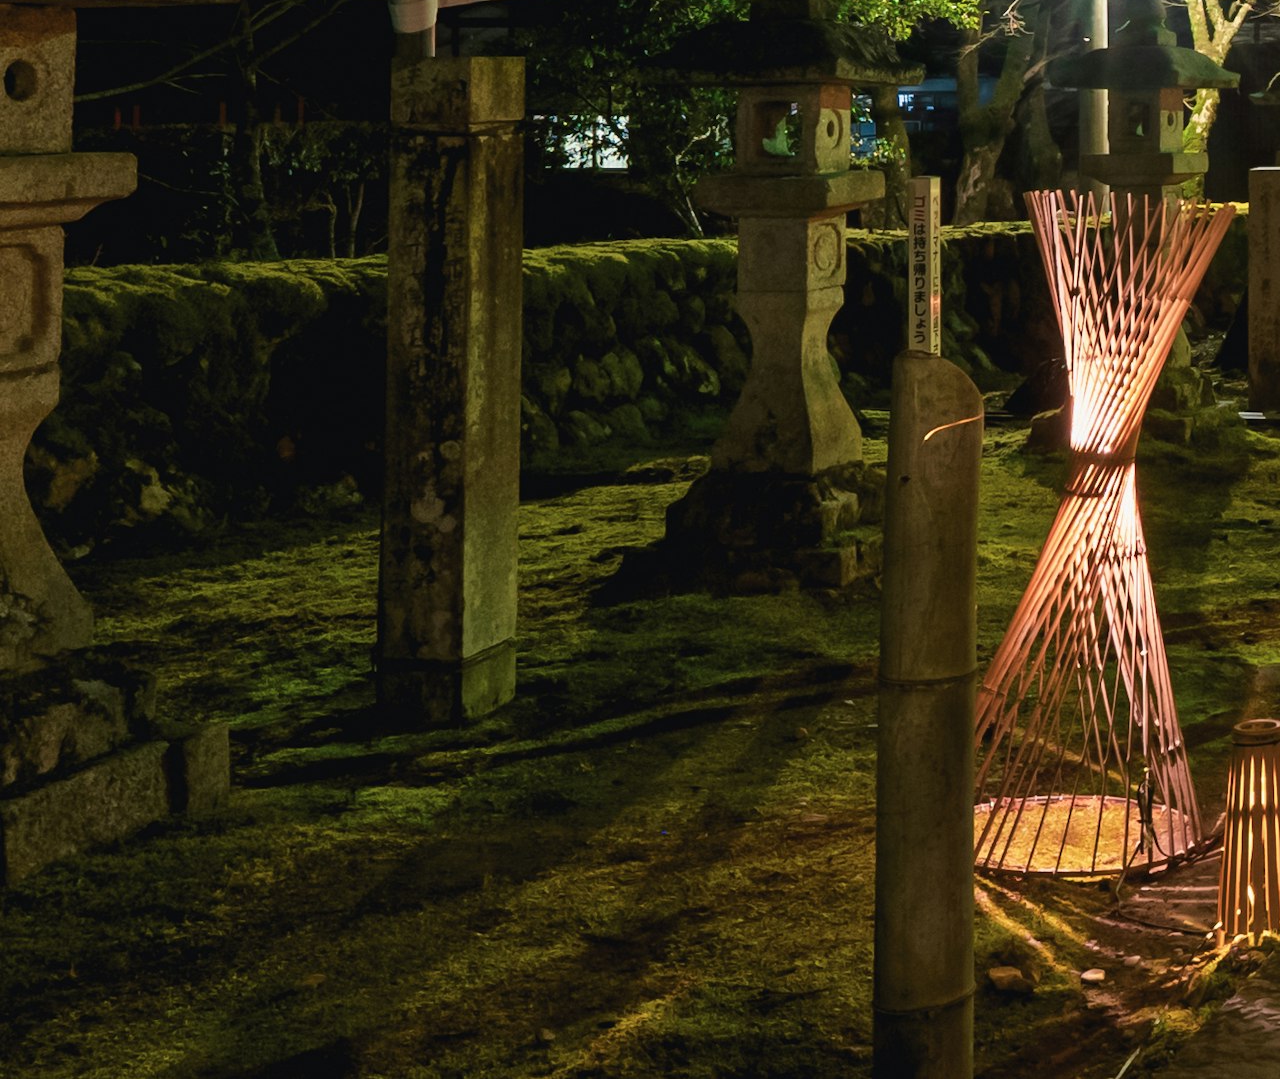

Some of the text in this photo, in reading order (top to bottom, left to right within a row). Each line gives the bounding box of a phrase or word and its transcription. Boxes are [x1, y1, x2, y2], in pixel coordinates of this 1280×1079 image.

[913, 195, 926, 344] ゴミは持ち帰りましょう
